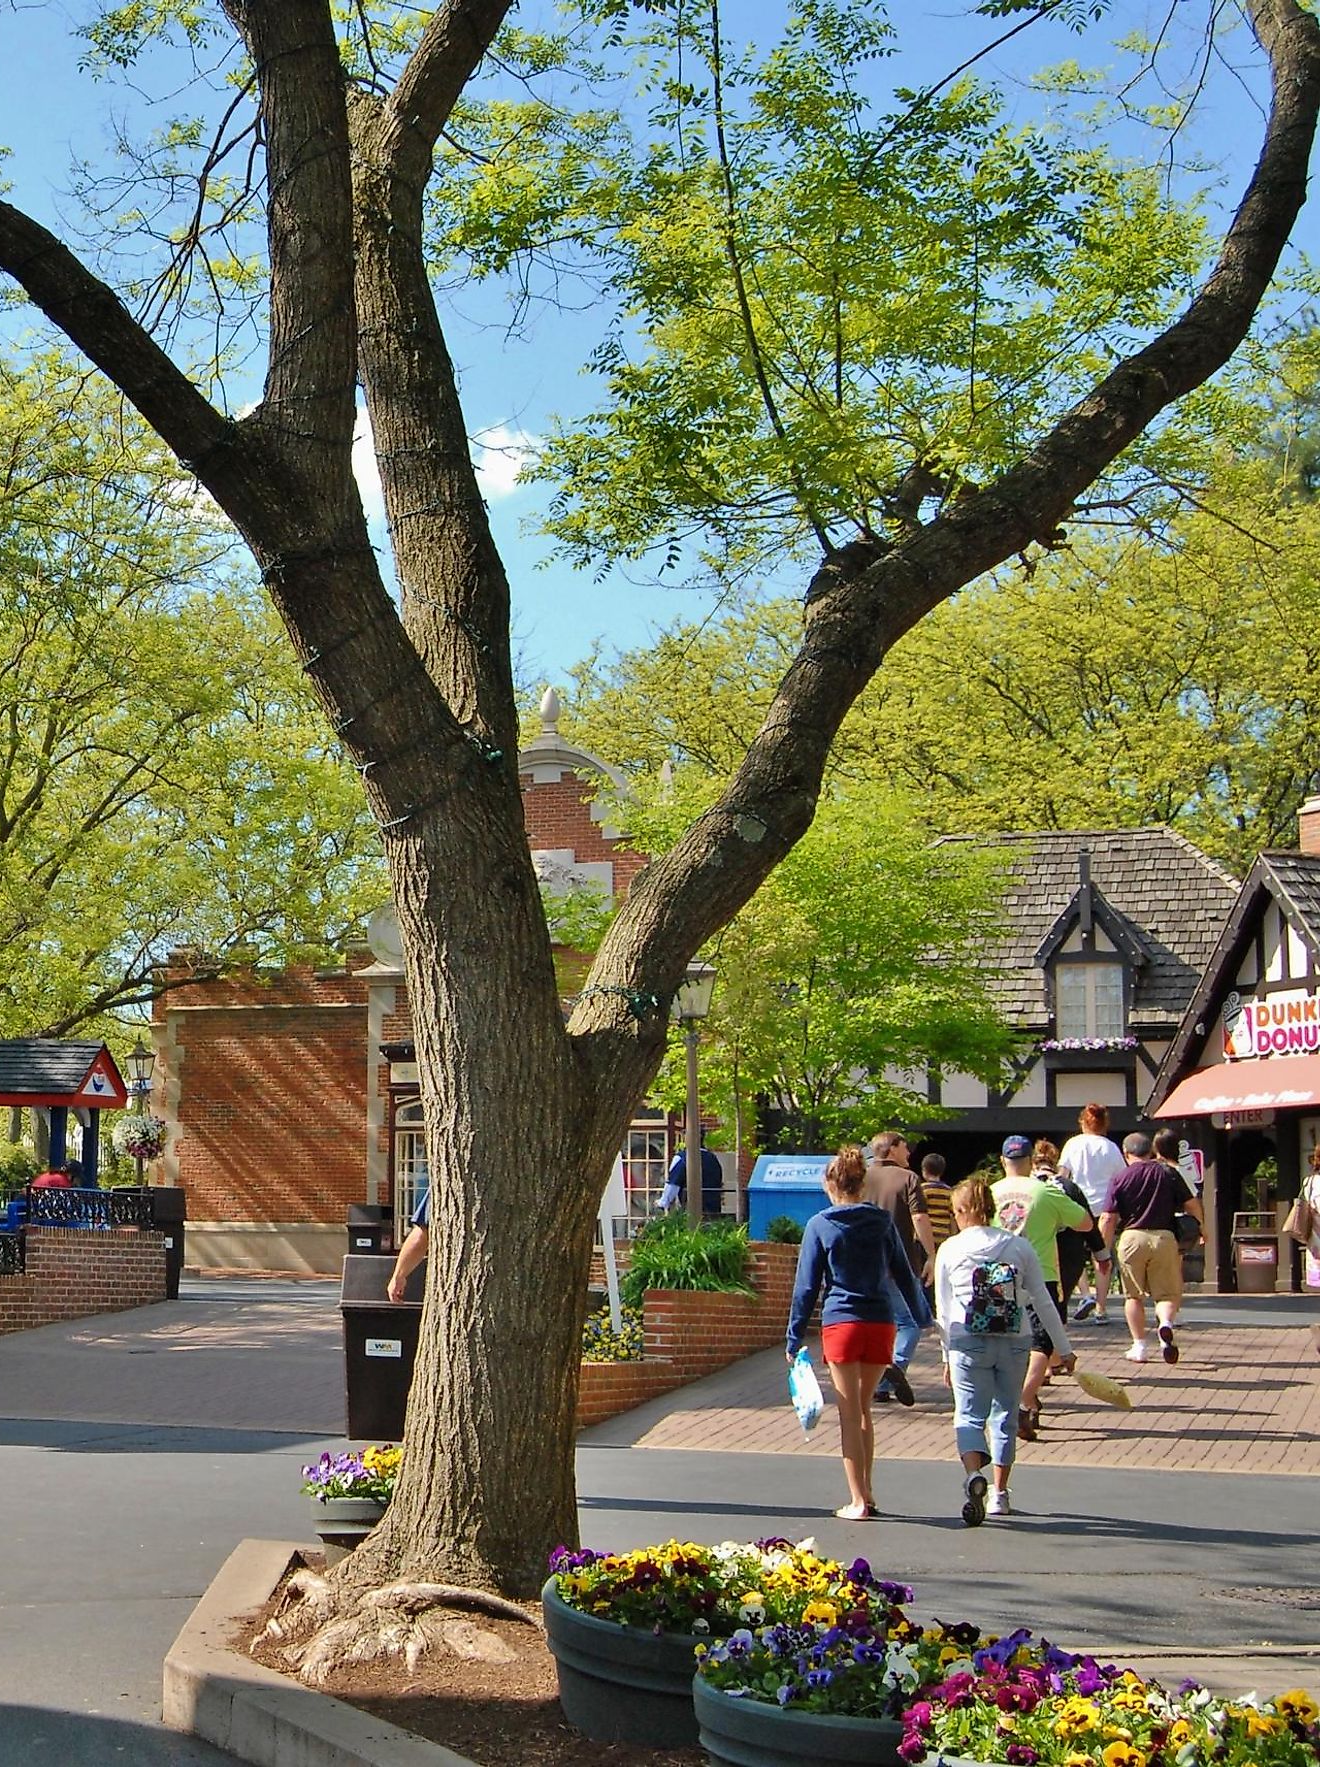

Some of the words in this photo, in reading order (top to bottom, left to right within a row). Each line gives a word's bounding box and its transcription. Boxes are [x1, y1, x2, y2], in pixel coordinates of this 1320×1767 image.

[1257, 999, 1320, 1027] DUNK
[1258, 1025, 1320, 1052] DONU
[1224, 1110, 1263, 1125] ENTER
[775, 1168, 819, 1177] RECYCLE
